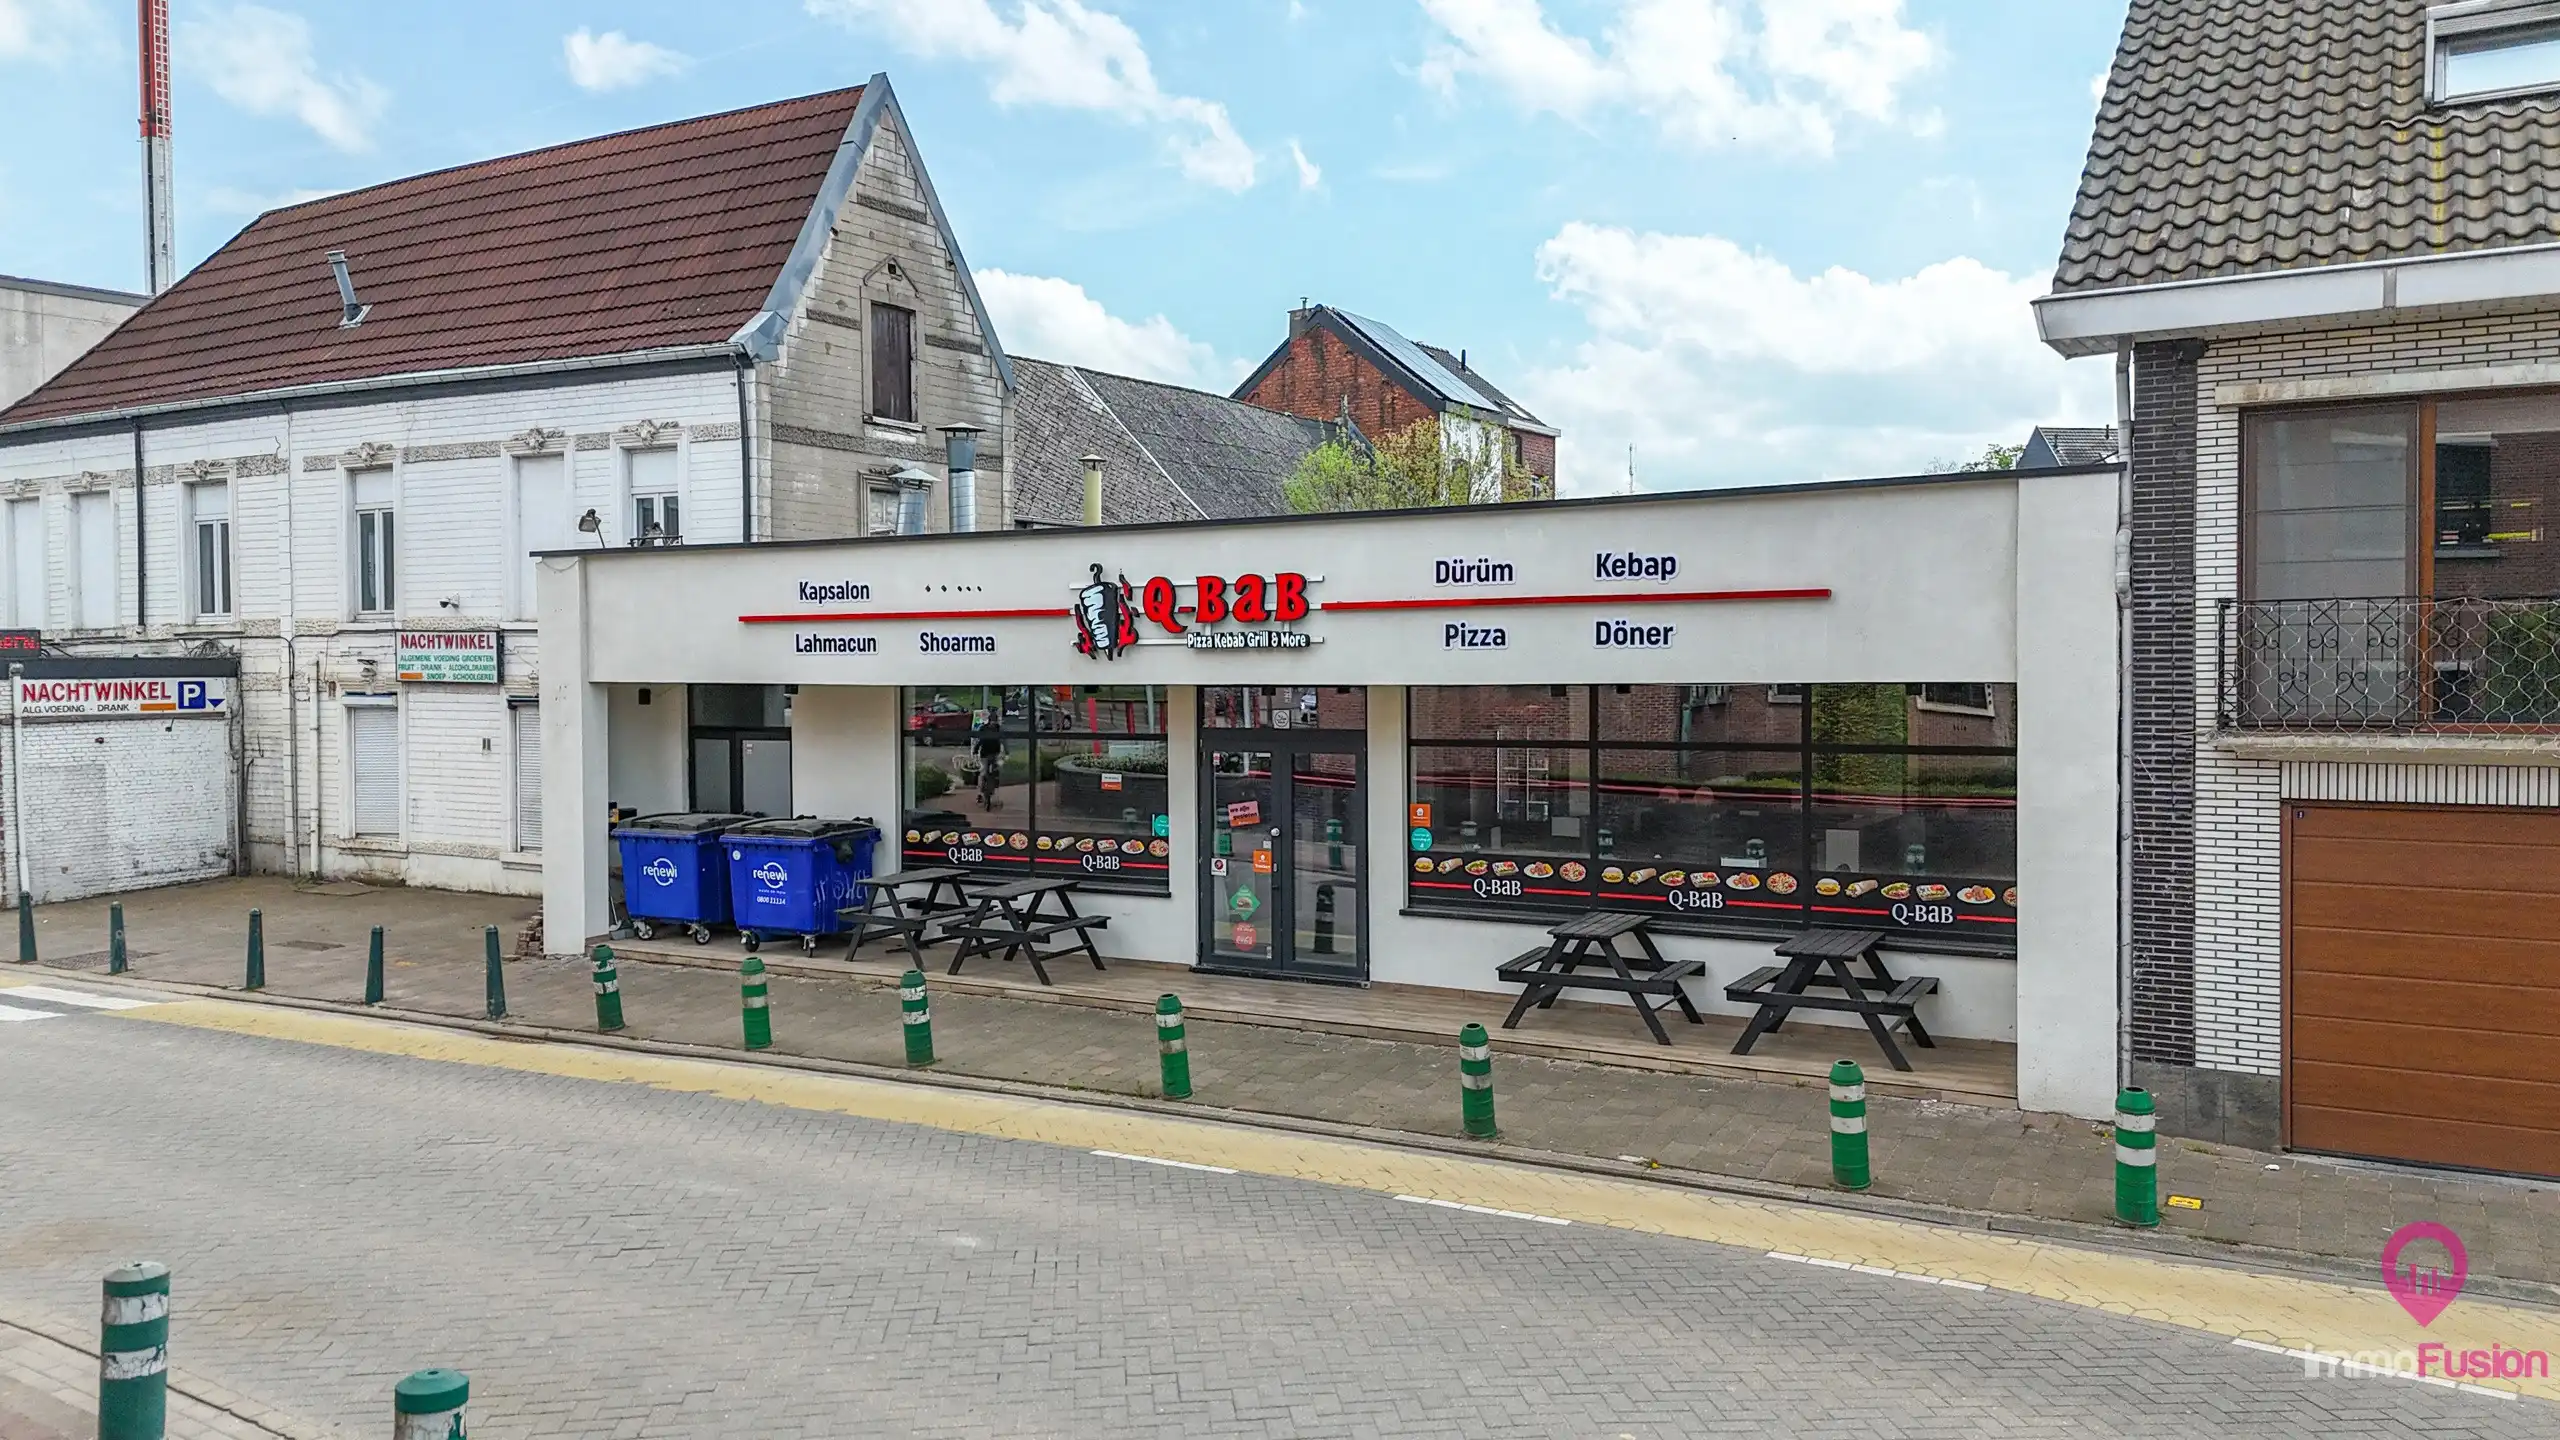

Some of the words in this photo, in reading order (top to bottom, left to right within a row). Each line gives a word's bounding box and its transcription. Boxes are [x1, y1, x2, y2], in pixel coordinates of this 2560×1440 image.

[1435, 558, 1513, 584] Dürüm
[1596, 552, 1676, 581] Kebap
[799, 580, 870, 604] Kapsalon
[401, 634, 494, 649] NACHTWINKEL
[795, 633, 877, 653] Lahmacun
[919, 631, 995, 652] Shoarma
[1187, 633, 1212, 648] Pizza
[1214, 632, 1245, 648] Kebab
[1247, 631, 1269, 647] Grill
[1271, 632, 1279, 646] &
[1280, 632, 1307, 648] More
[1445, 622, 1506, 648] Pizza
[1595, 620, 1674, 646] Döner
[401, 654, 431, 662] ALGEMENE
[434, 654, 460, 662] VOEDING
[462, 654, 494, 662] GROENTEN
[453, 673, 494, 681] SCHOOLGEREI
[22, 681, 171, 703] NACHTWINKEL
[183, 684, 201, 706] P
[45, 703, 85, 713] VOEDING
[97, 703, 129, 712] DRANK
[643, 864, 678, 879] renewi
[753, 867, 788, 882] renewi
